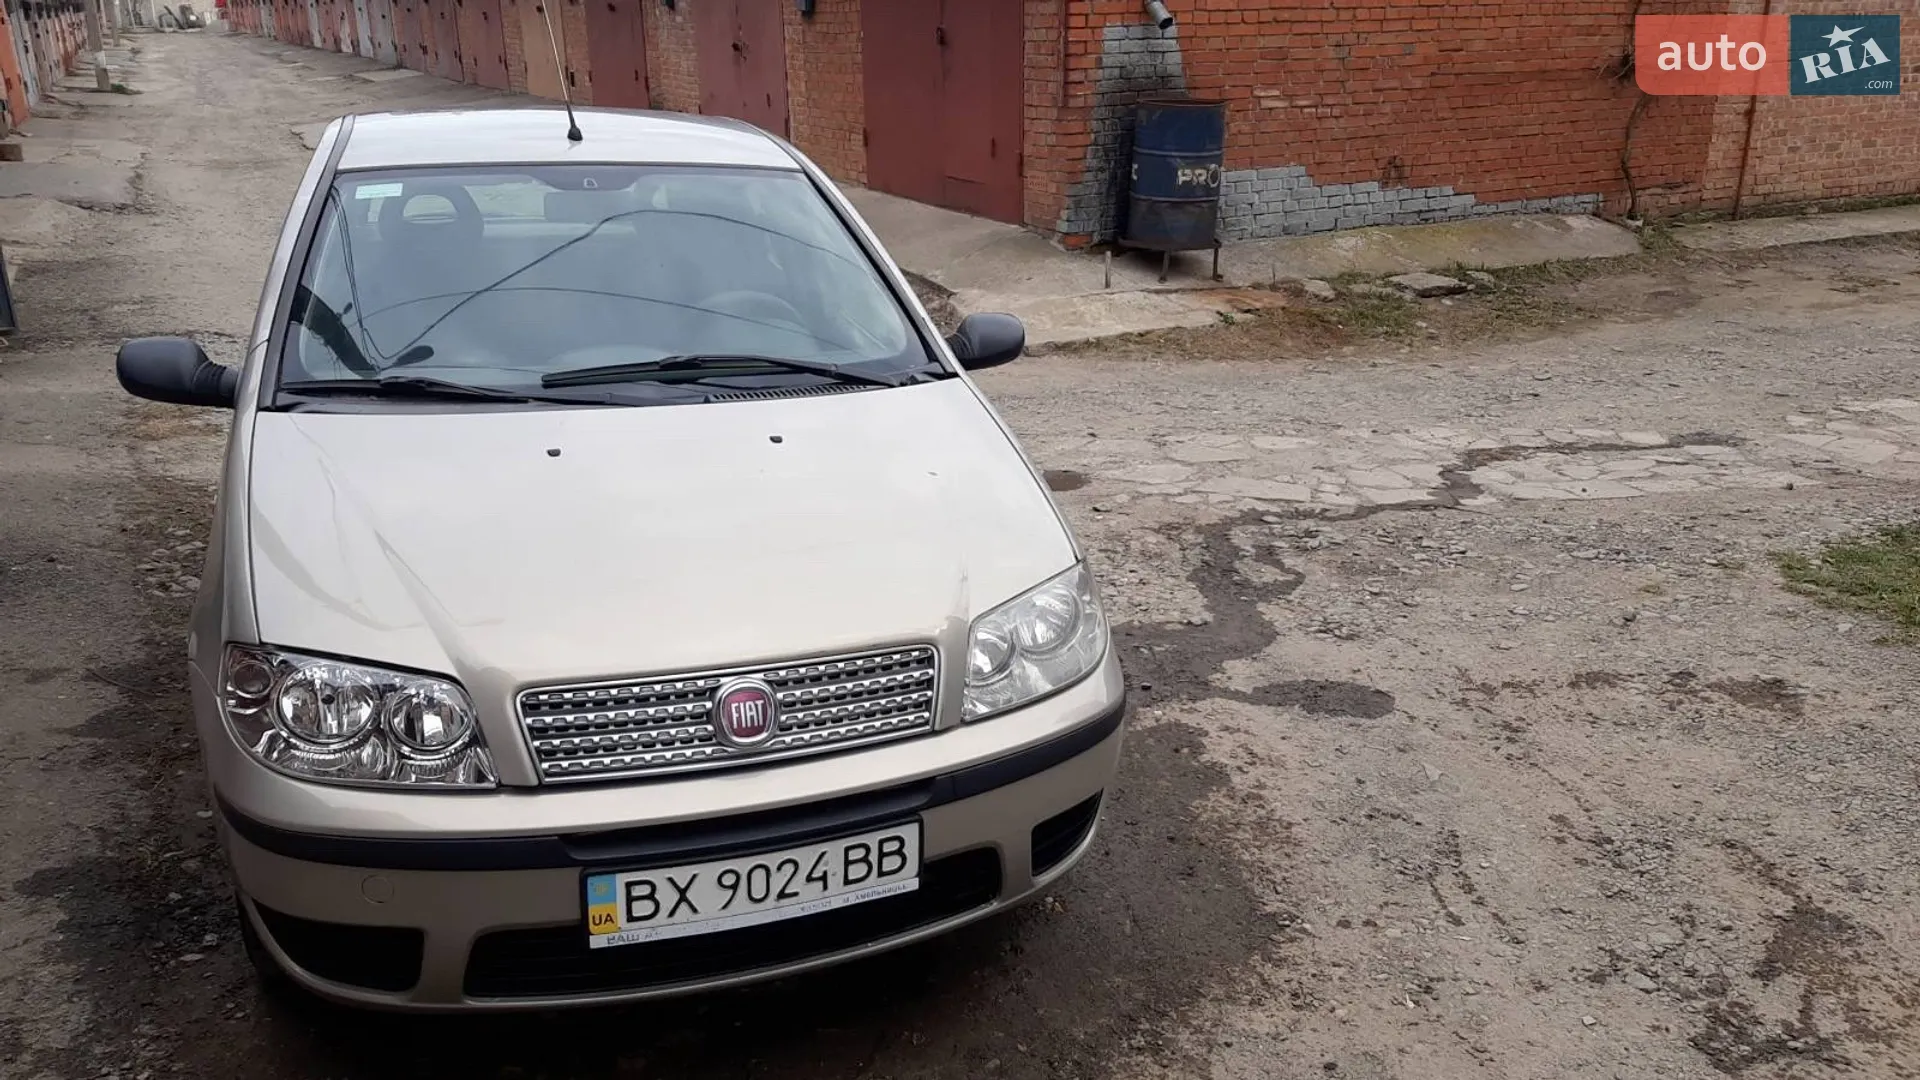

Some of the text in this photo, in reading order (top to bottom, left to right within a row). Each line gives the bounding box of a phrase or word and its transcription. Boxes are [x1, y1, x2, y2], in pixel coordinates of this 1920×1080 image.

[1177, 163, 1220, 188] PRO
[731, 699, 765, 730] FIAT
[625, 835, 908, 923] BX 9024 BB
[592, 913, 615, 927] UA
